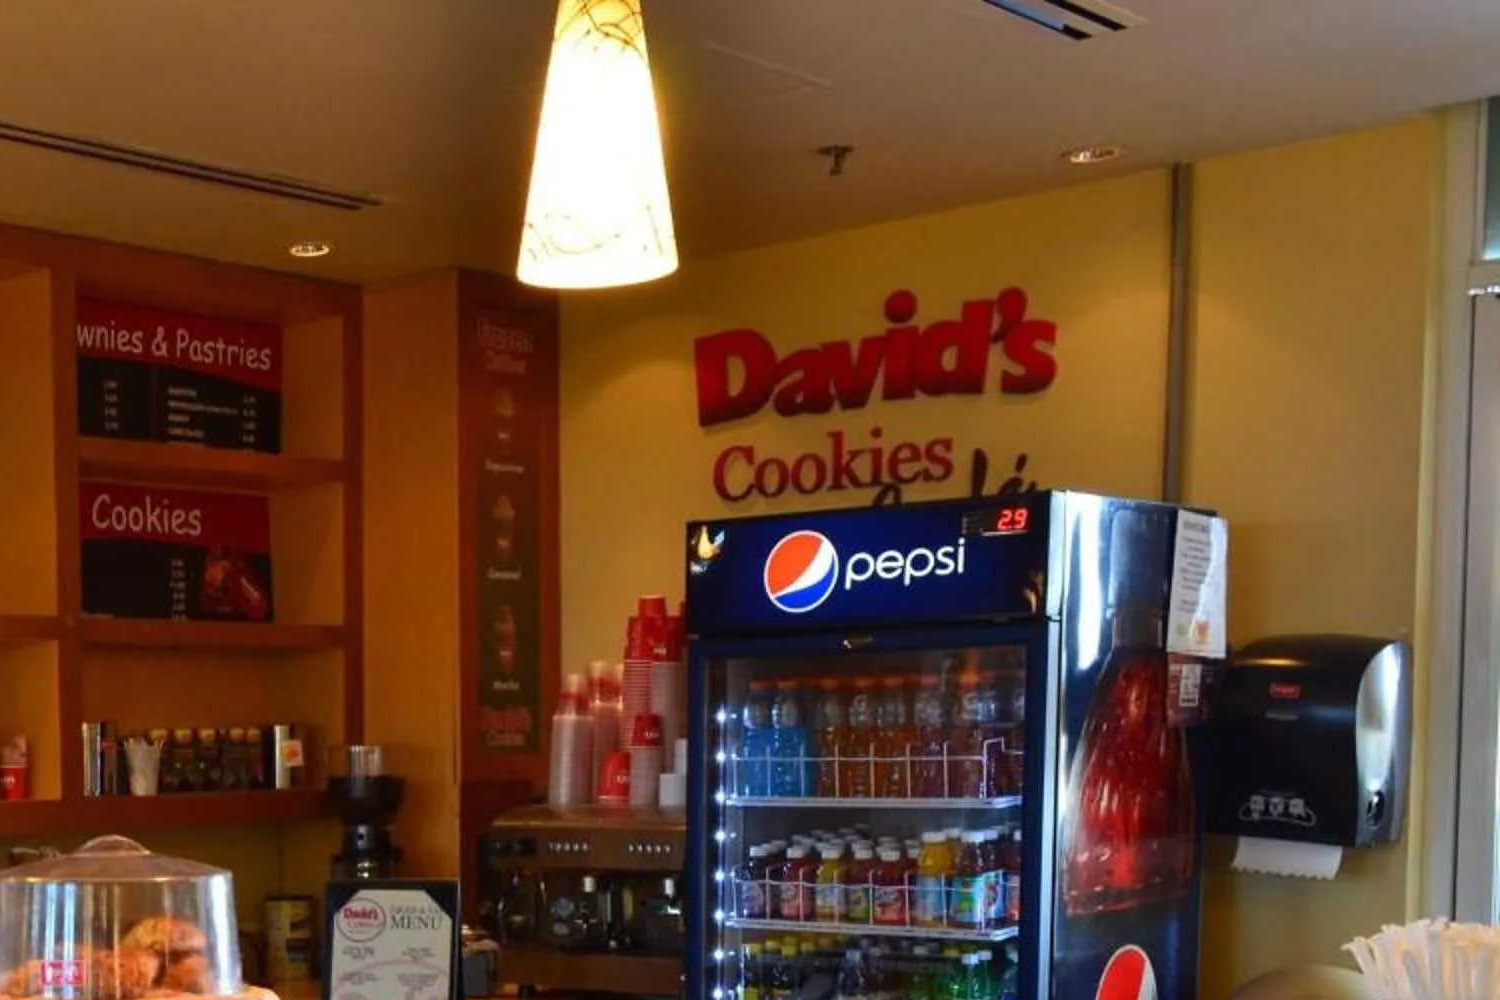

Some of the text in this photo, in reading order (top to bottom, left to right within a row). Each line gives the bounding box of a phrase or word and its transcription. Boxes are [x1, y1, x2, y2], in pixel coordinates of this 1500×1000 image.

[77, 320, 272, 371] wnies & Pastries
[693, 285, 1058, 428] David's
[712, 427, 954, 504] Cookies
[91, 493, 203, 536] Cookies
[844, 537, 966, 590] pepsi
[389, 915, 443, 930] MENU
